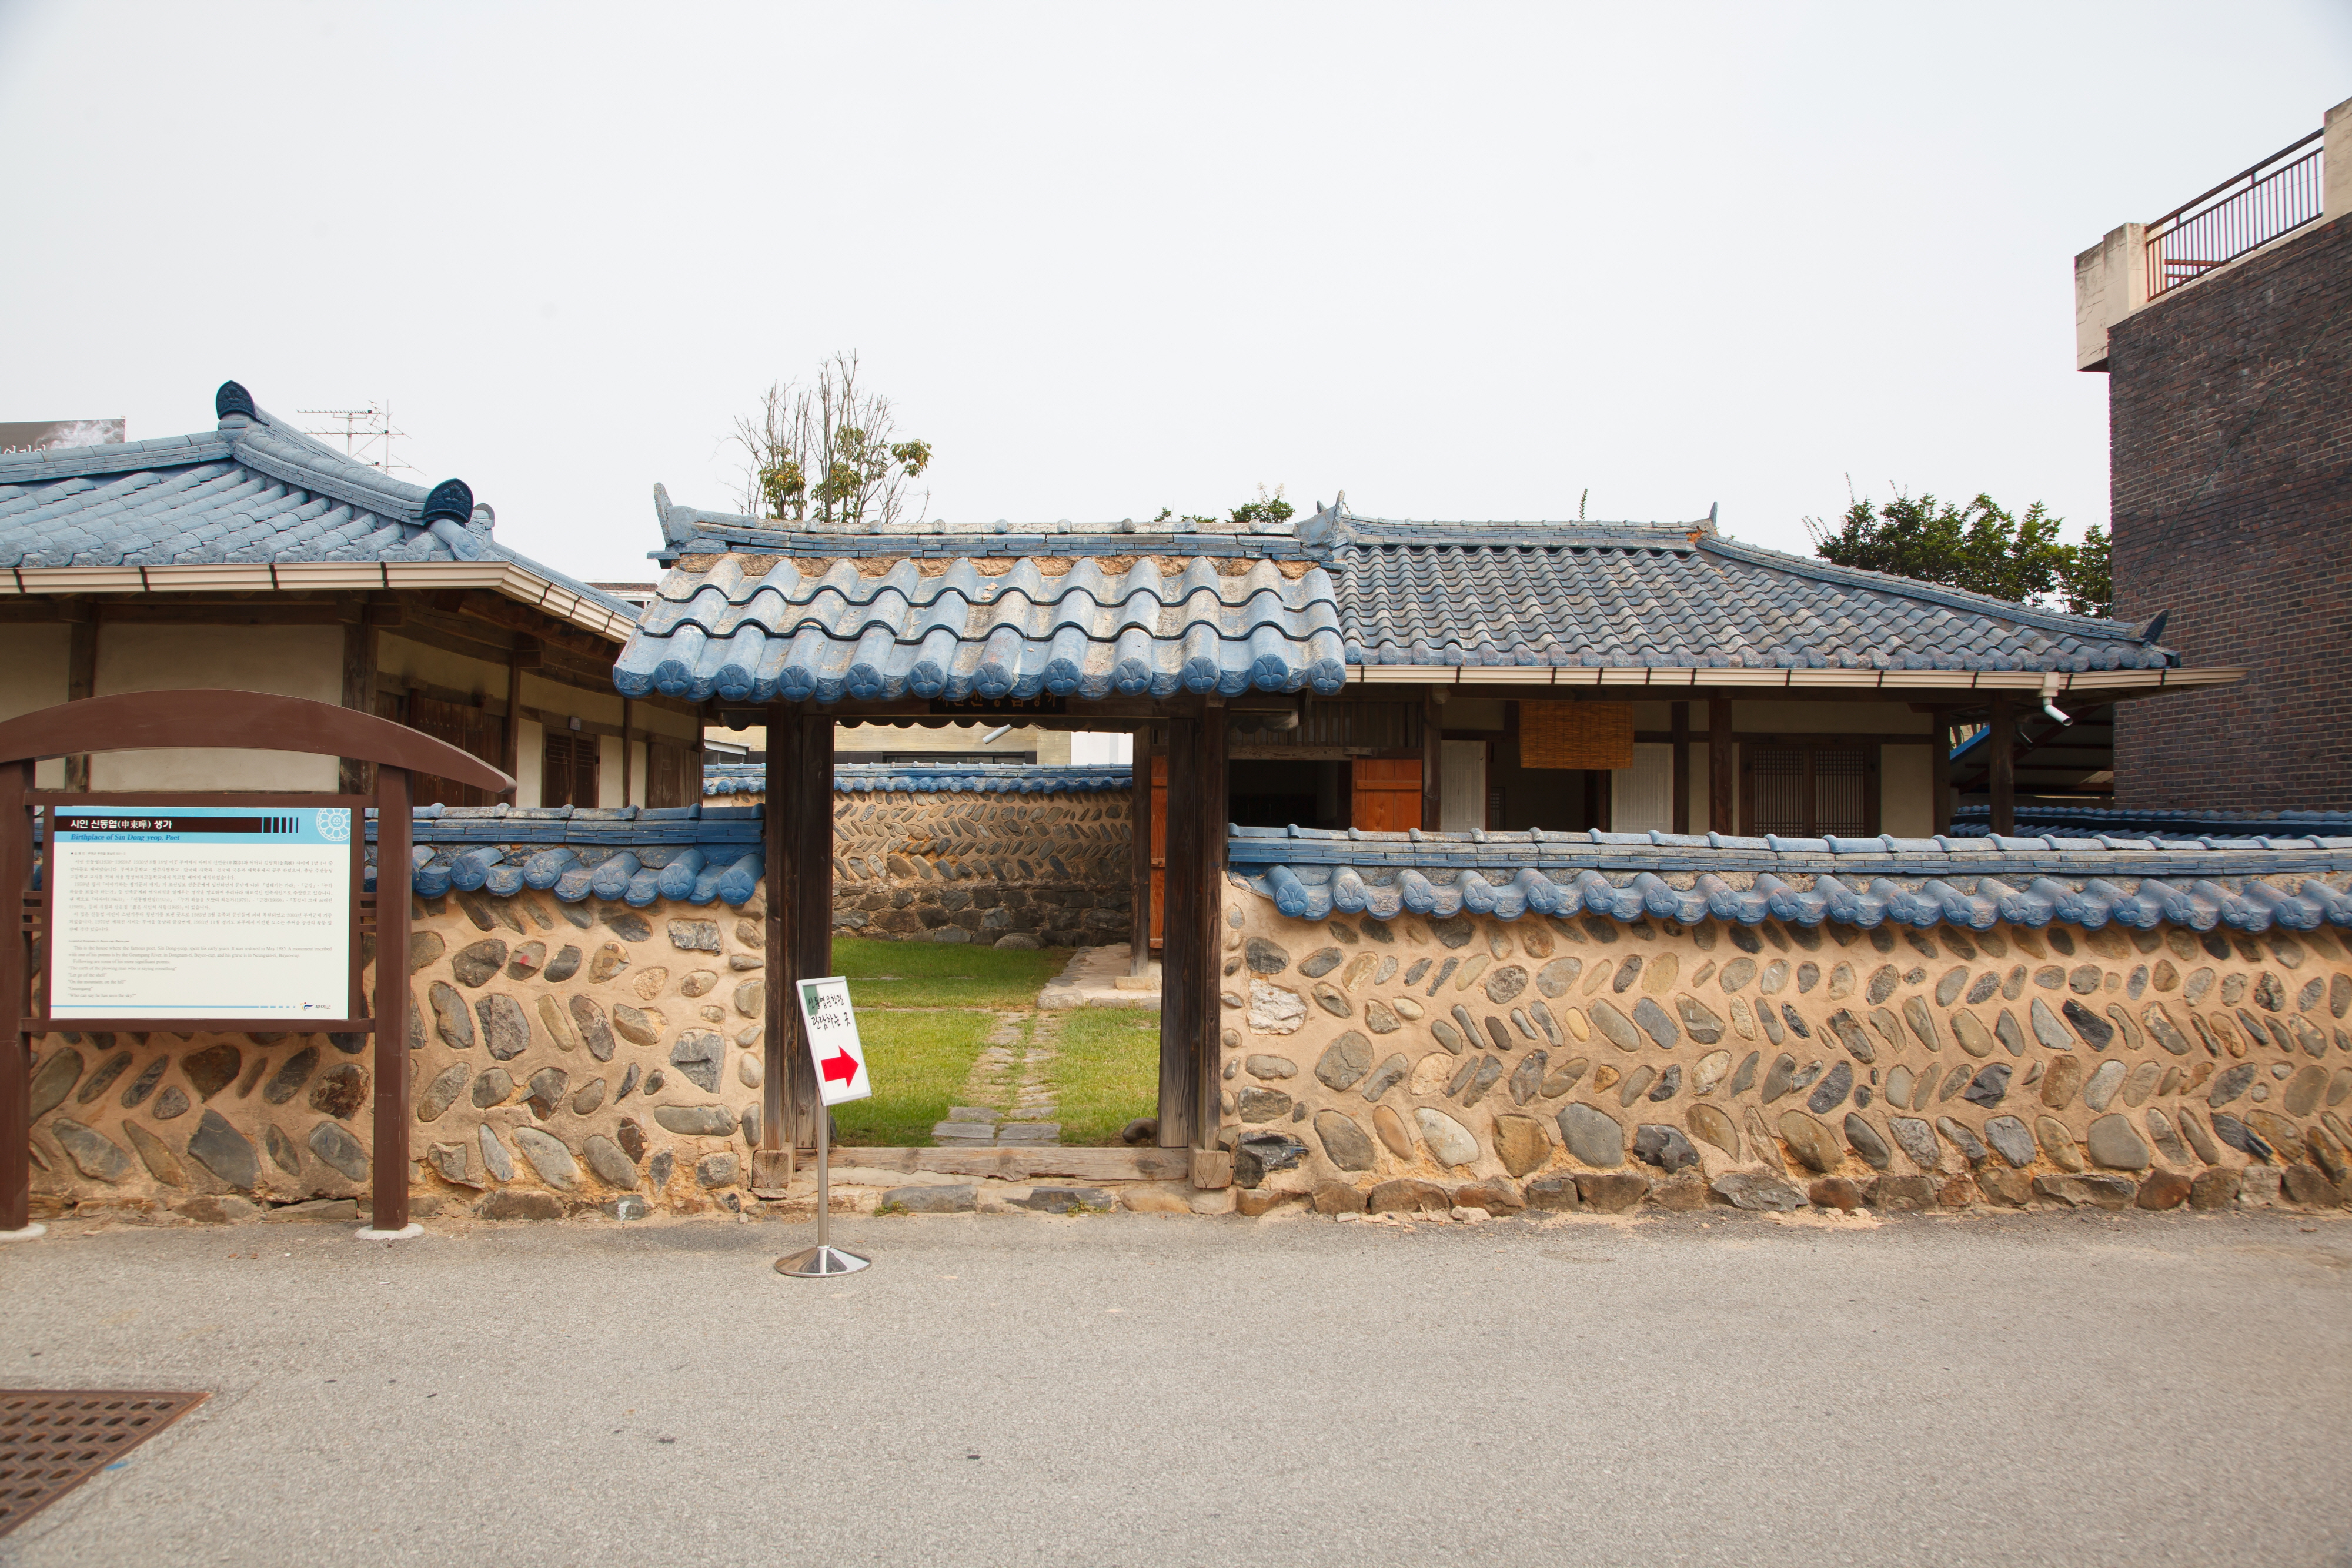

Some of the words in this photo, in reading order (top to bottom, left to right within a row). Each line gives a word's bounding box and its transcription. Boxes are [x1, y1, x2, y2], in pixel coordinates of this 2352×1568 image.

[71, 820, 88, 828] 시인
[154, 820, 172, 829] 생가
[808, 994, 844, 1009] 신동엽문학관
[811, 1014, 841, 1031] 관람하는
[844, 1012, 851, 1027] 곳
